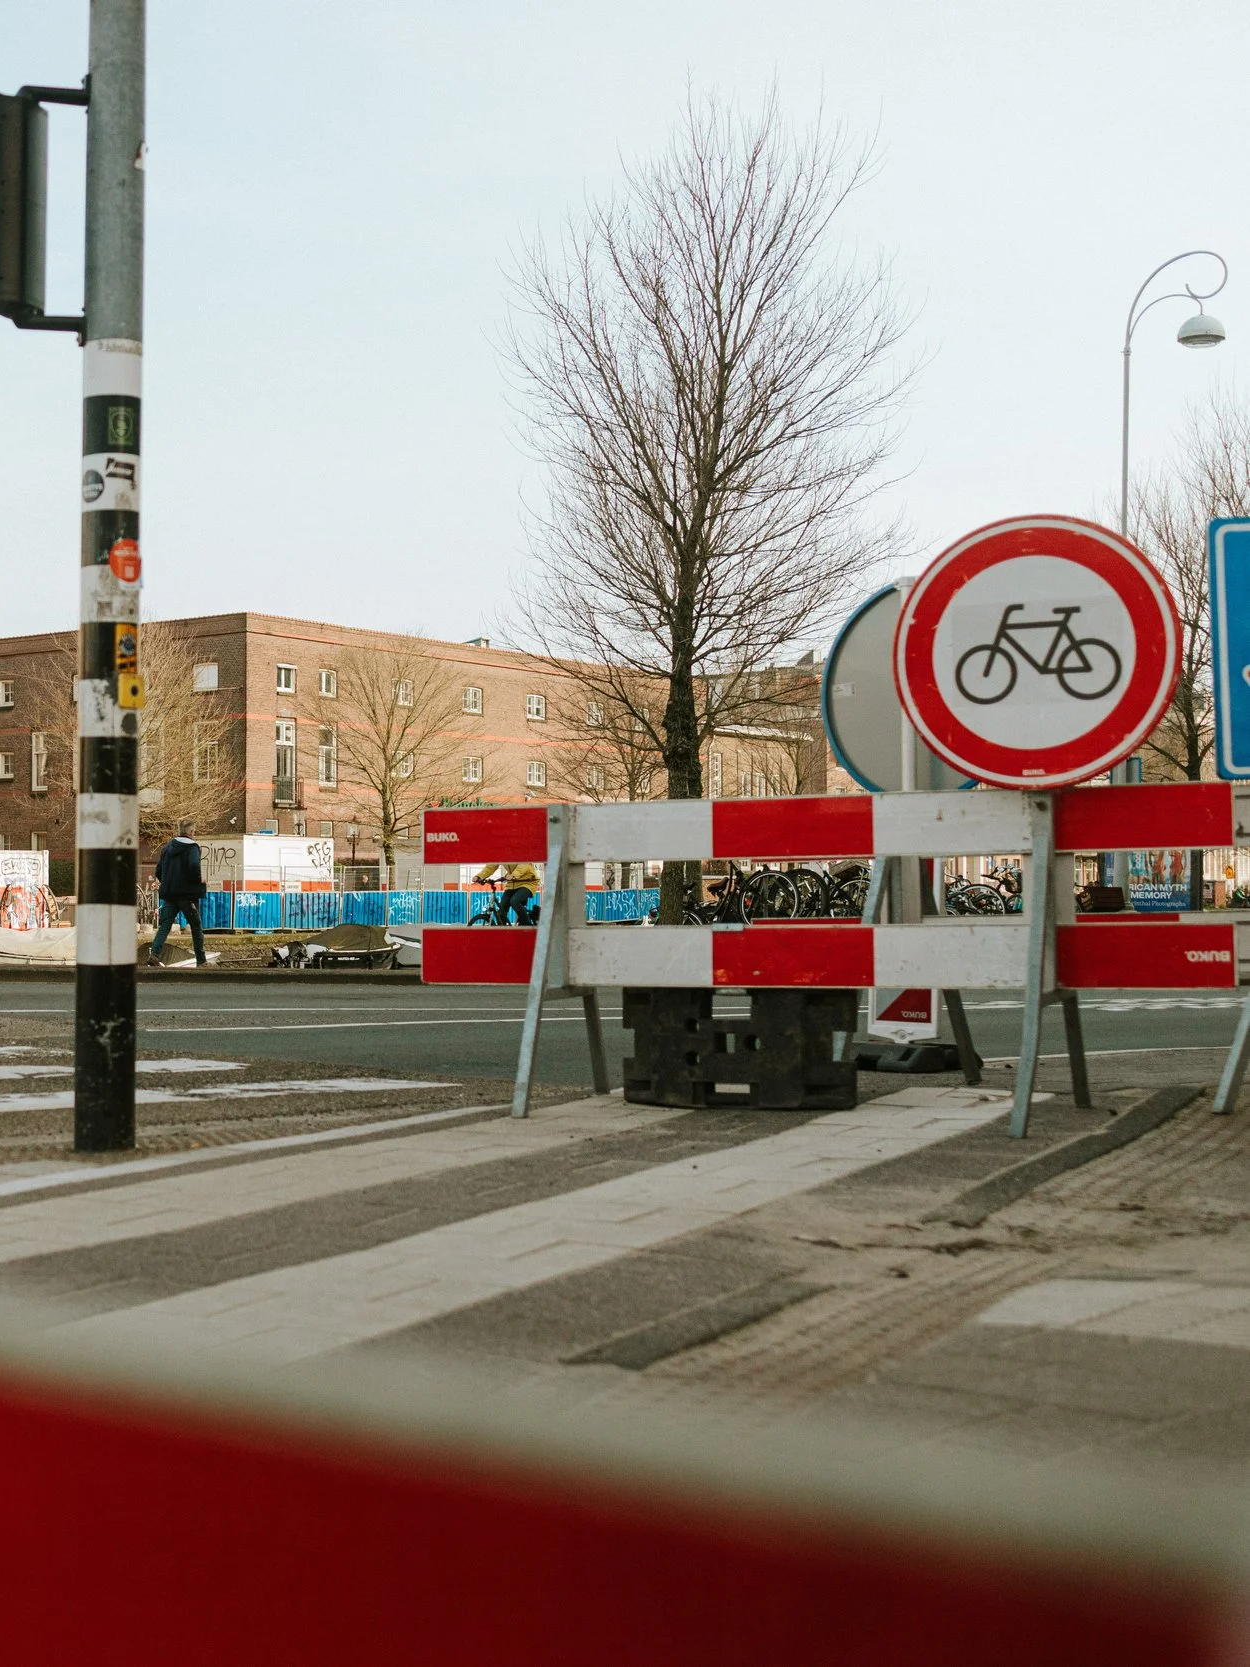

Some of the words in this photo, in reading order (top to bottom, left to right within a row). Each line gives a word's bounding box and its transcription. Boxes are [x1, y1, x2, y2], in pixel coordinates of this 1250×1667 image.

[426, 831, 460, 843] BUKO.
[1130, 891, 1172, 899] MEMORY
[1184, 950, 1231, 962] BUKO.
[901, 1010, 928, 1019] BUKO.
